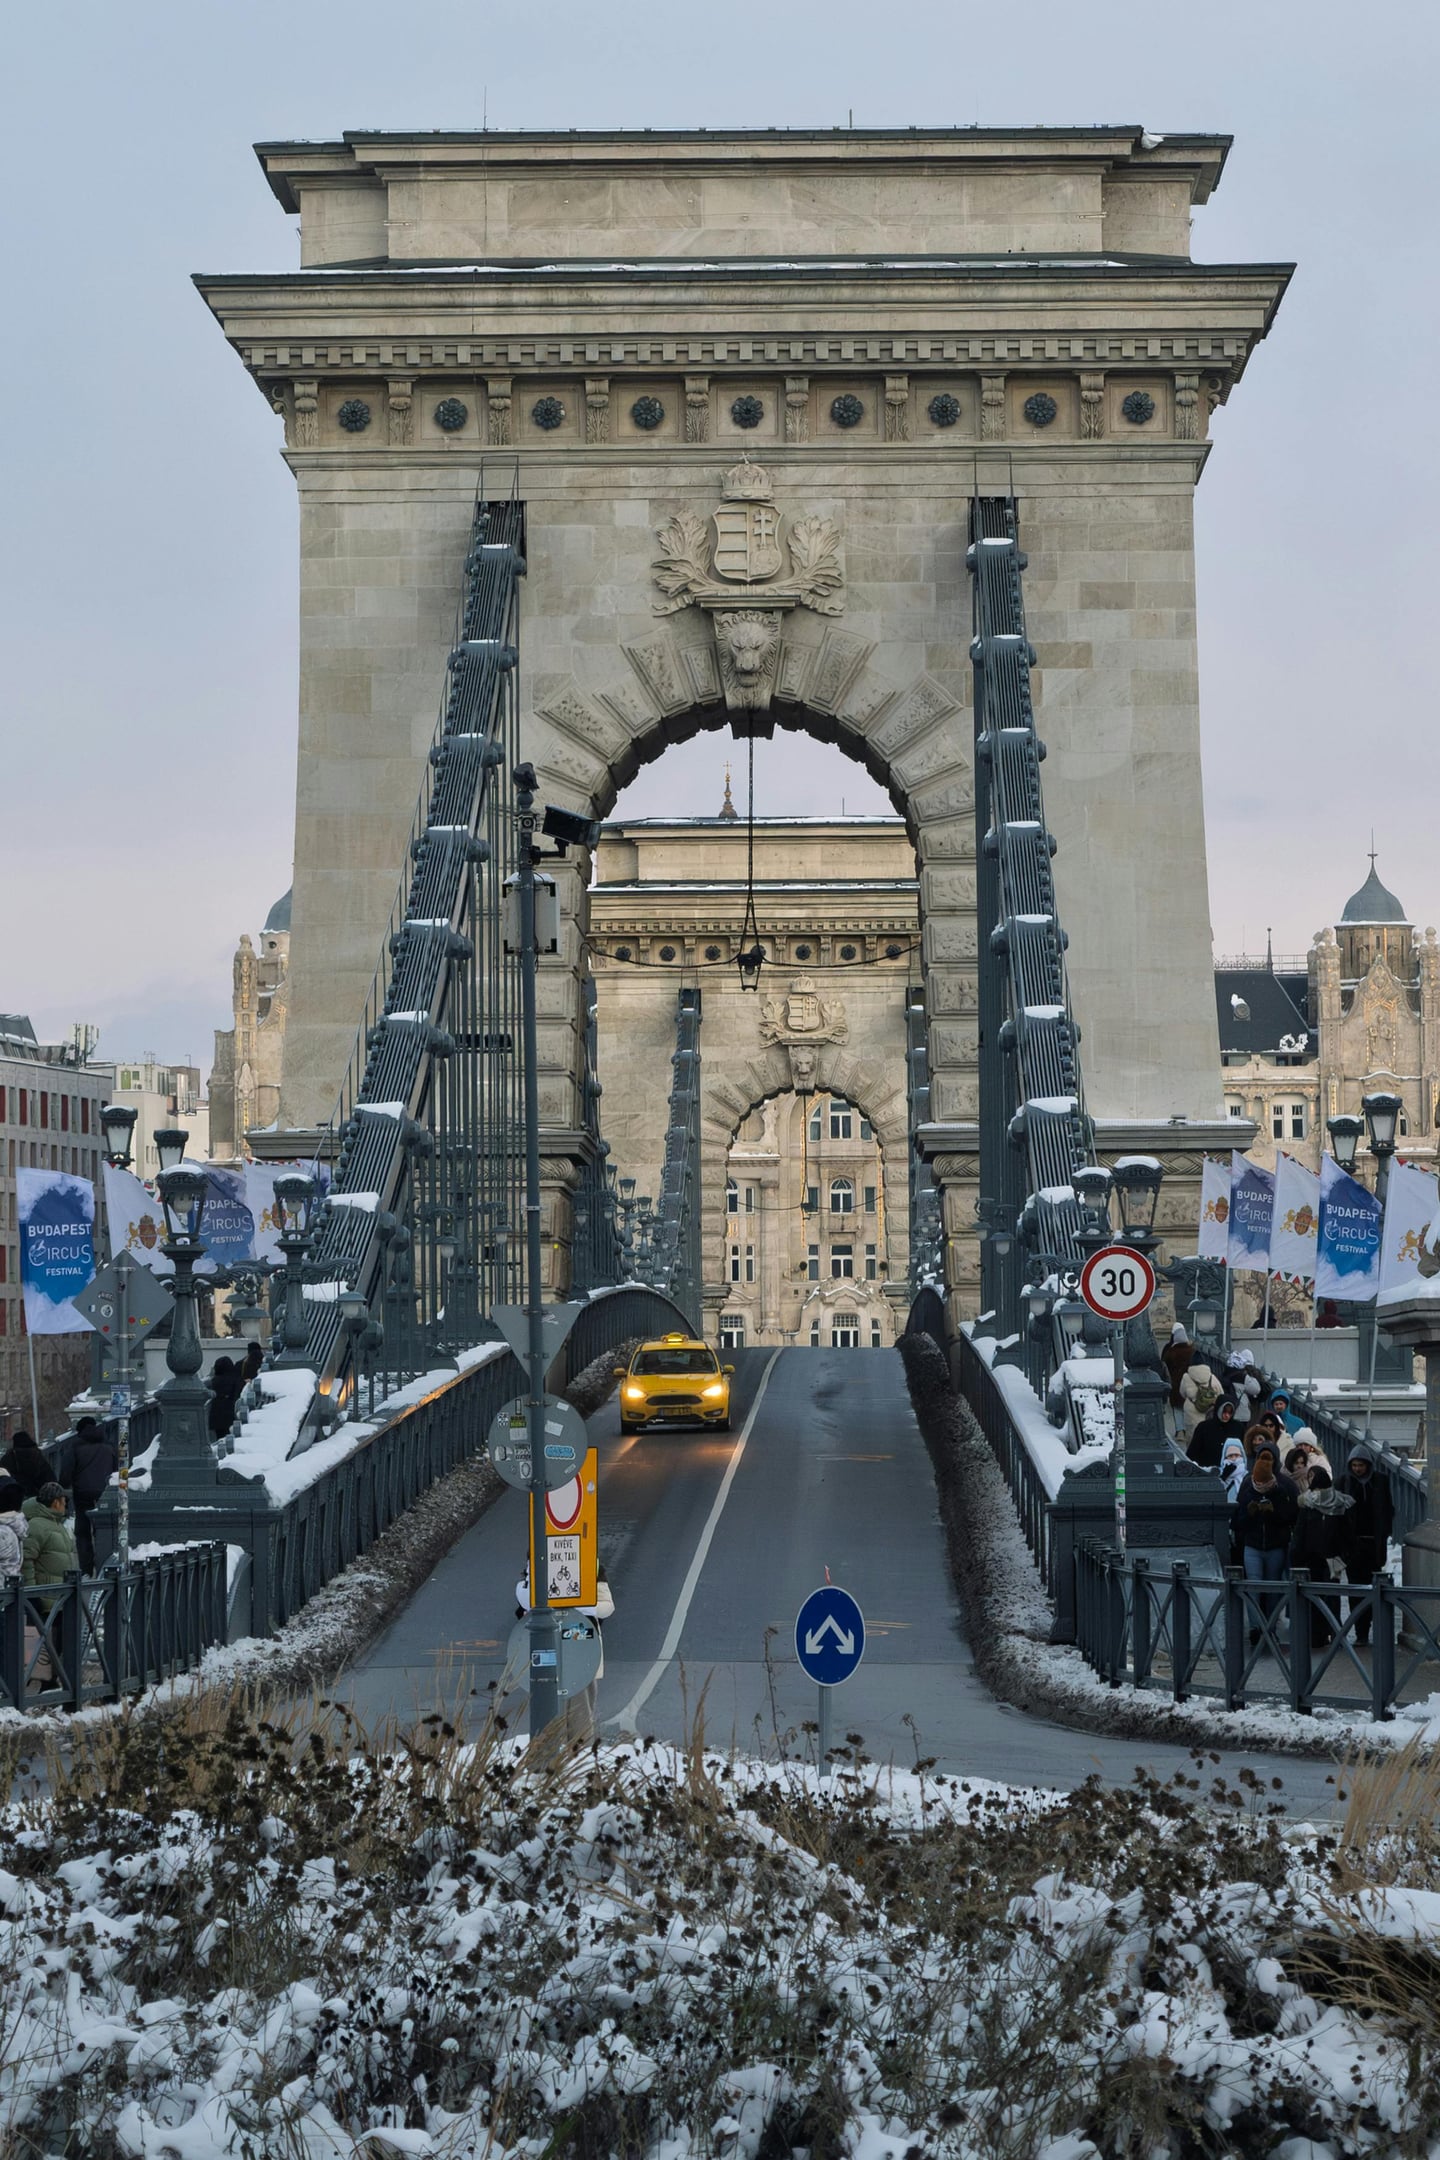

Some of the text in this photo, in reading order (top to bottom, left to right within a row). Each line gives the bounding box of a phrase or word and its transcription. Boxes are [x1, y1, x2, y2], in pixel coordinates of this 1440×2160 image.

[1236, 1190, 1273, 1204] BUDAPE
[1235, 1202, 1273, 1223] CIRCU
[28, 1224, 92, 1237] BUDAPEST
[1324, 1219, 1379, 1245] CIRCUS
[210, 1235, 245, 1244] FESTIVAL
[28, 1239, 92, 1267] CIRCUS
[1335, 1244, 1369, 1254] FESTIVAL
[45, 1267, 83, 1277] FESTIVAL
[1101, 1268, 1135, 1297] 30
[564, 1552, 577, 1561] TAXI
